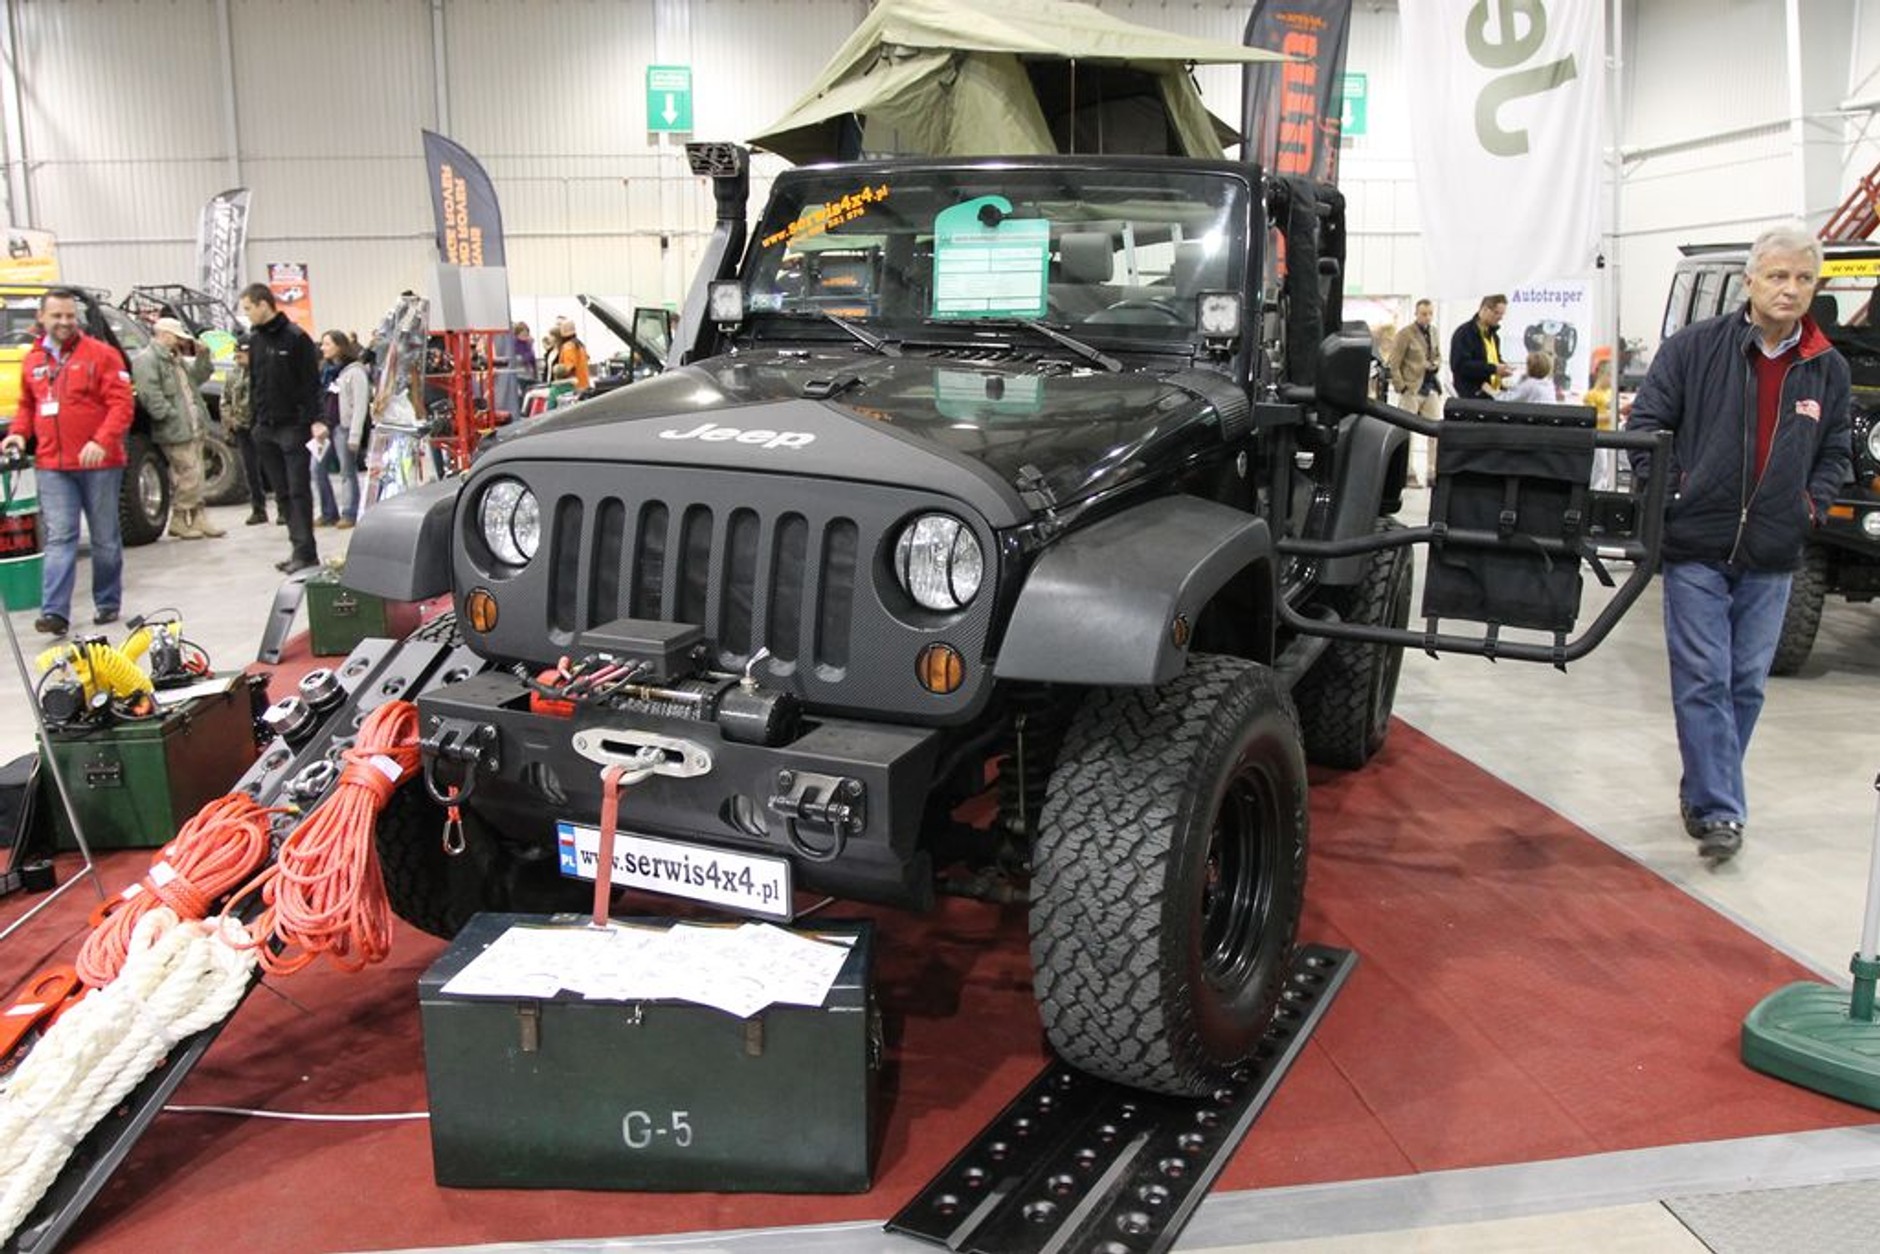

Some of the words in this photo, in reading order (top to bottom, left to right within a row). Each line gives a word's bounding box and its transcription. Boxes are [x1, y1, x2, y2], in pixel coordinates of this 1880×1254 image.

[1512, 289, 1583, 308] Autotraper
[658, 423, 816, 449] Jeep
[561, 853, 577, 868] PL
[622, 1110, 693, 1149] G-5
